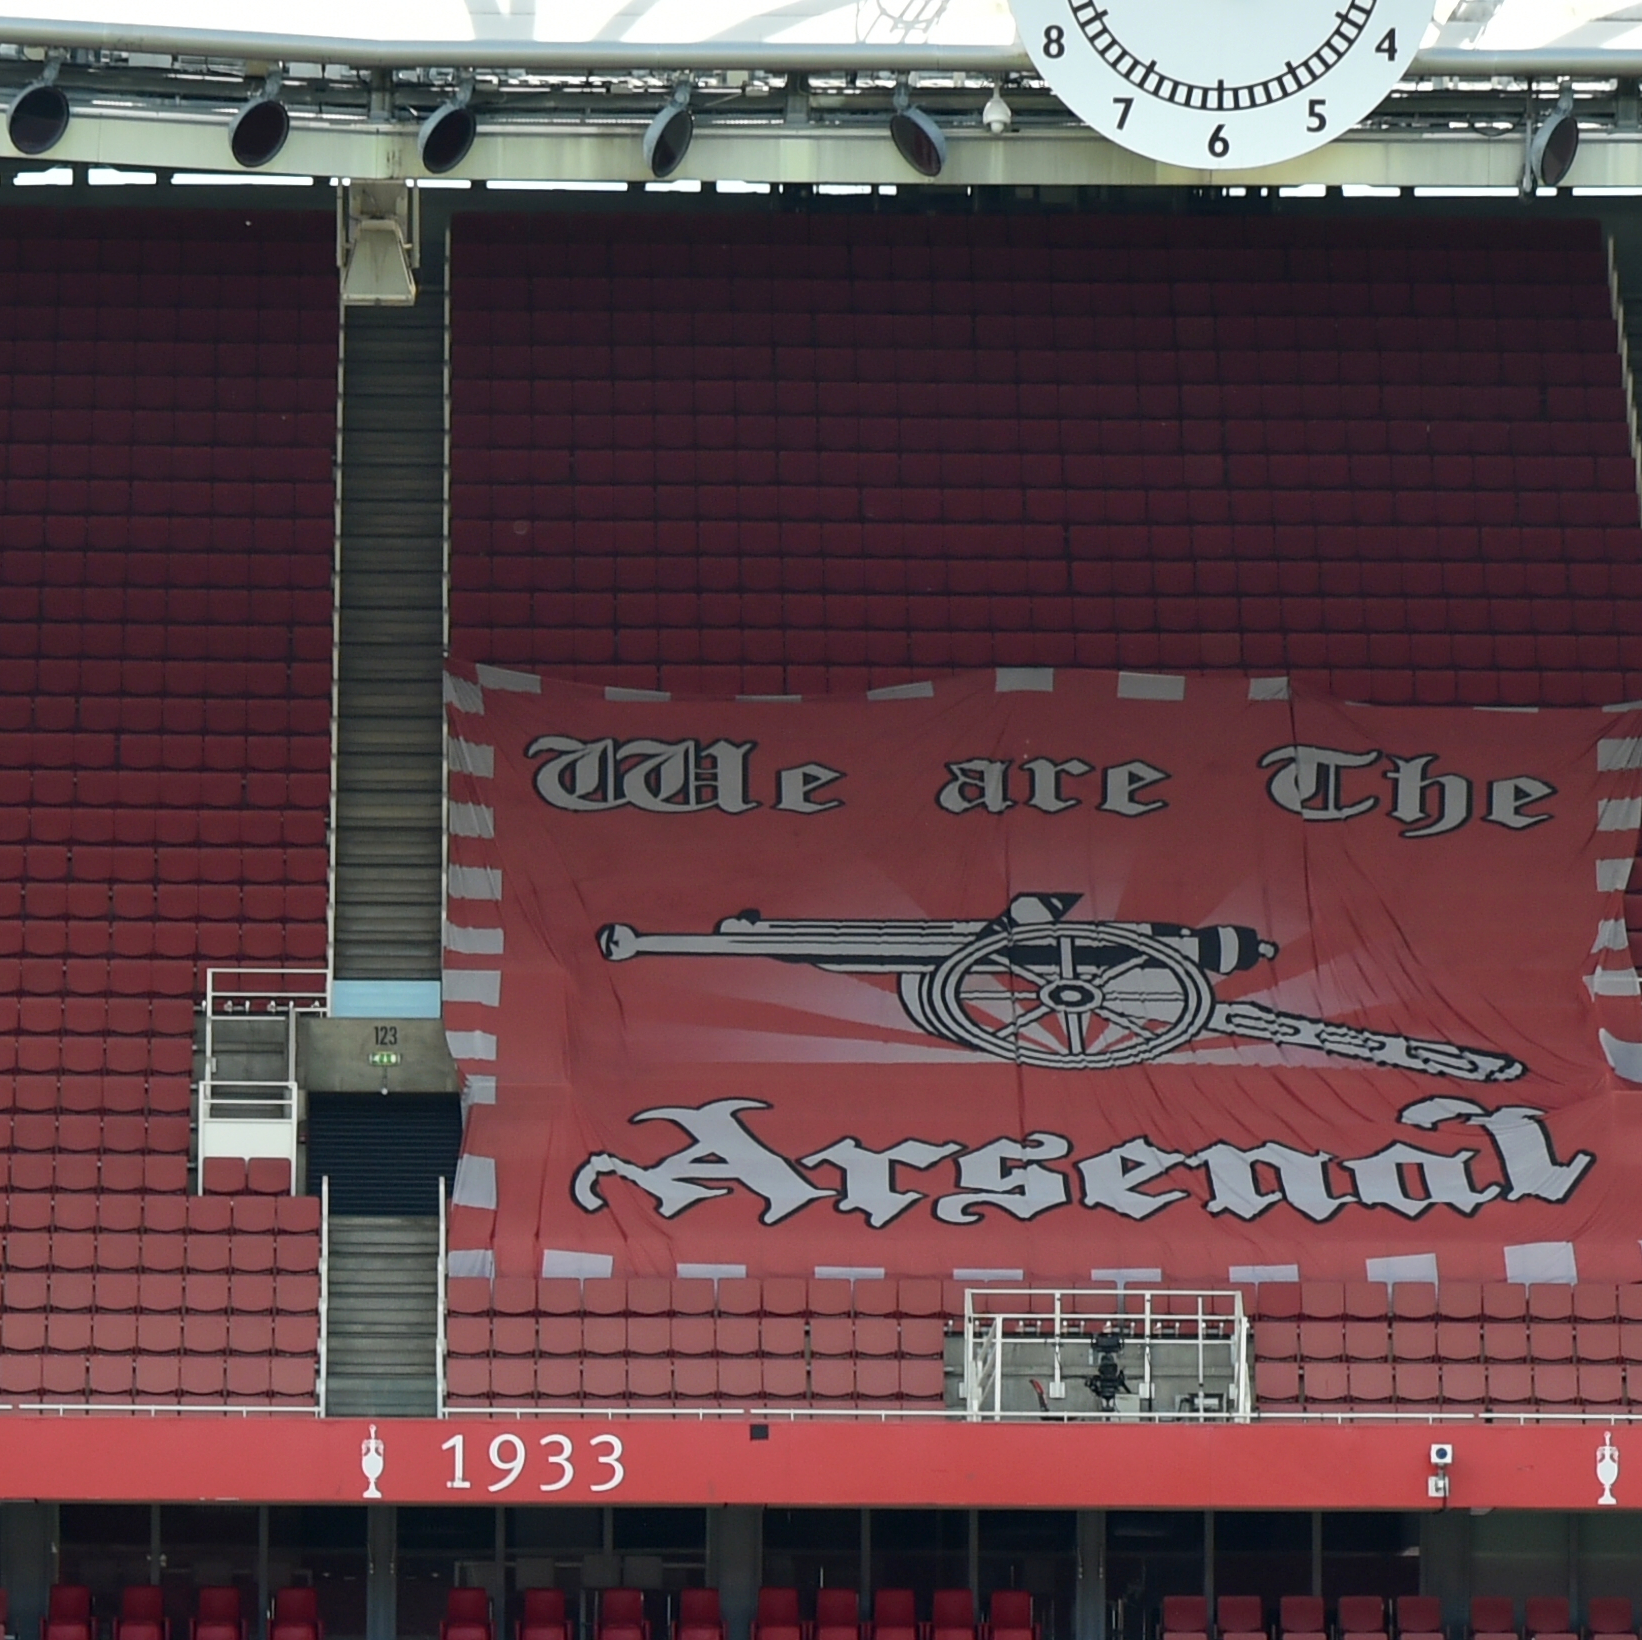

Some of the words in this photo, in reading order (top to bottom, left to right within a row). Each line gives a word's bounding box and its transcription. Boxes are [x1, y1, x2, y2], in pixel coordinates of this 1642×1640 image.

[1043, 25, 1065, 59] 8
[1375, 28, 1398, 61] 4
[1112, 97, 1134, 130] 7
[1306, 99, 1327, 133] 5
[1208, 125, 1229, 158] 6
[525, 735, 844, 816] We
[937, 746, 1169, 816] are
[1260, 743, 1555, 839] The
[374, 1026, 398, 1045] 123
[571, 1097, 1595, 1227] Arsenal
[441, 1434, 625, 1492] 1933
